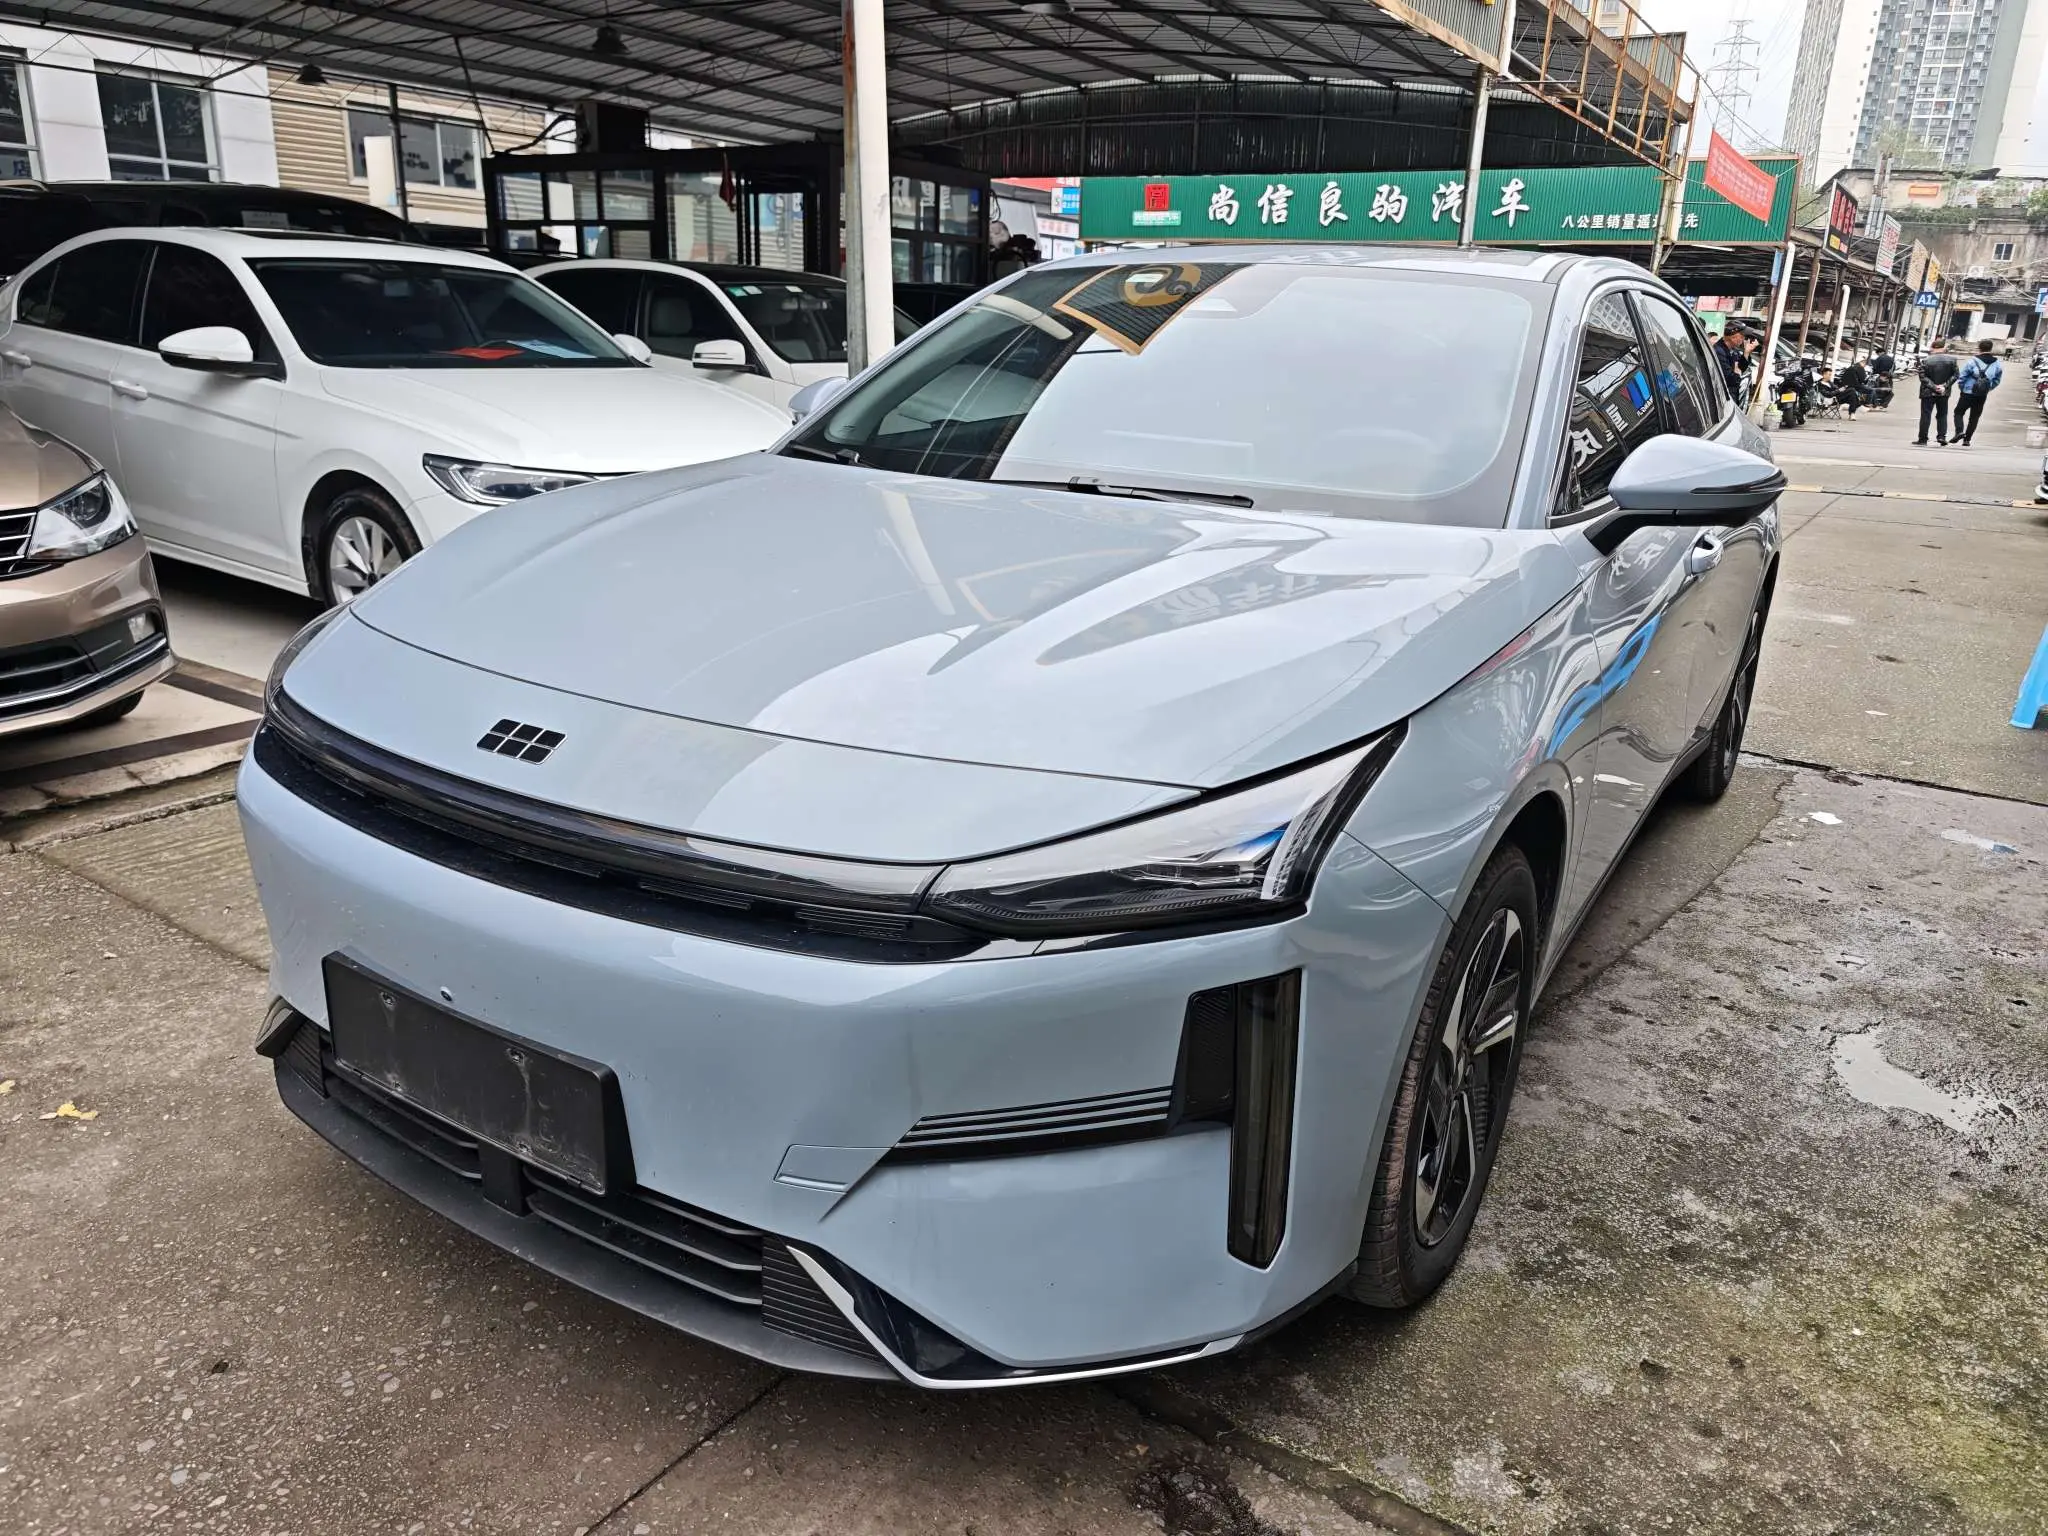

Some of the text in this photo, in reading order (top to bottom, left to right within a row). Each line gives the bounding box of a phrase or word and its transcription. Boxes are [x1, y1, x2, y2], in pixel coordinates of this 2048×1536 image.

[1208, 178, 1531, 228] 尚信良驹汽车
[1561, 213, 1699, 230] 八公里销量遥先
